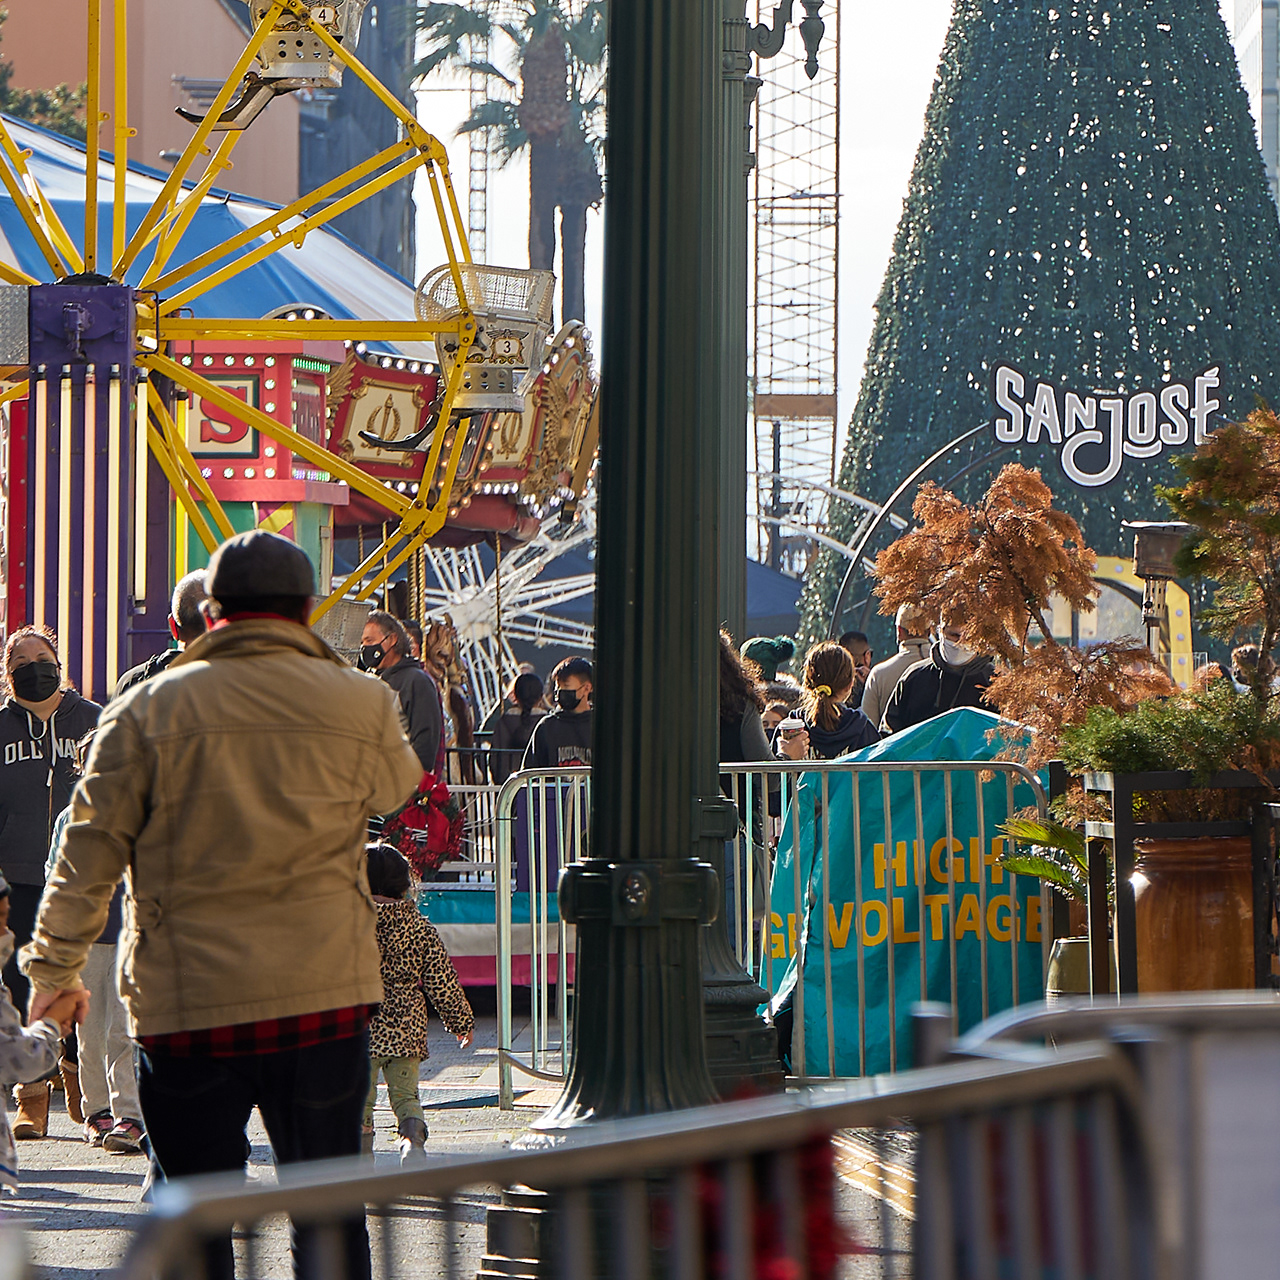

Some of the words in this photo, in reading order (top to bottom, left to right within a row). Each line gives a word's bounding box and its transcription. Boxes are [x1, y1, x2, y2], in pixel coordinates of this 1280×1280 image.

[318, 8, 327, 23] 4
[503, 340, 512, 354] 3
[872, 837, 1004, 889] HIGH
[828, 893, 1054, 949] VOLTAGE
